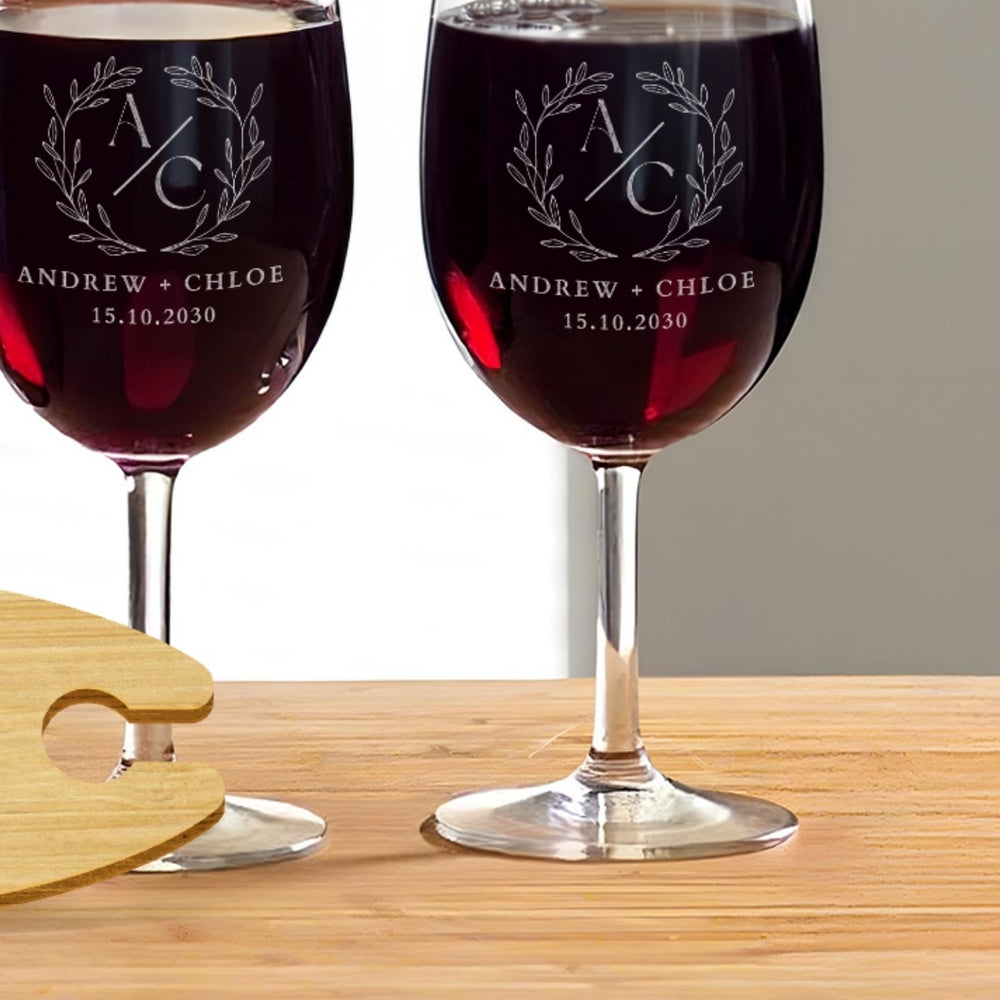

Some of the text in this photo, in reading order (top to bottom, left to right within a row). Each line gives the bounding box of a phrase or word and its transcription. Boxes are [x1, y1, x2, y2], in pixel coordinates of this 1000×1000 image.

[17, 265, 147, 293] ANDREW
[184, 264, 284, 292] CHLOE
[489, 271, 619, 299] ANDREW
[656, 270, 756, 297] CHLOE
[92, 306, 216, 326] 15.10.2030
[563, 312, 688, 331] 15.10.2030
